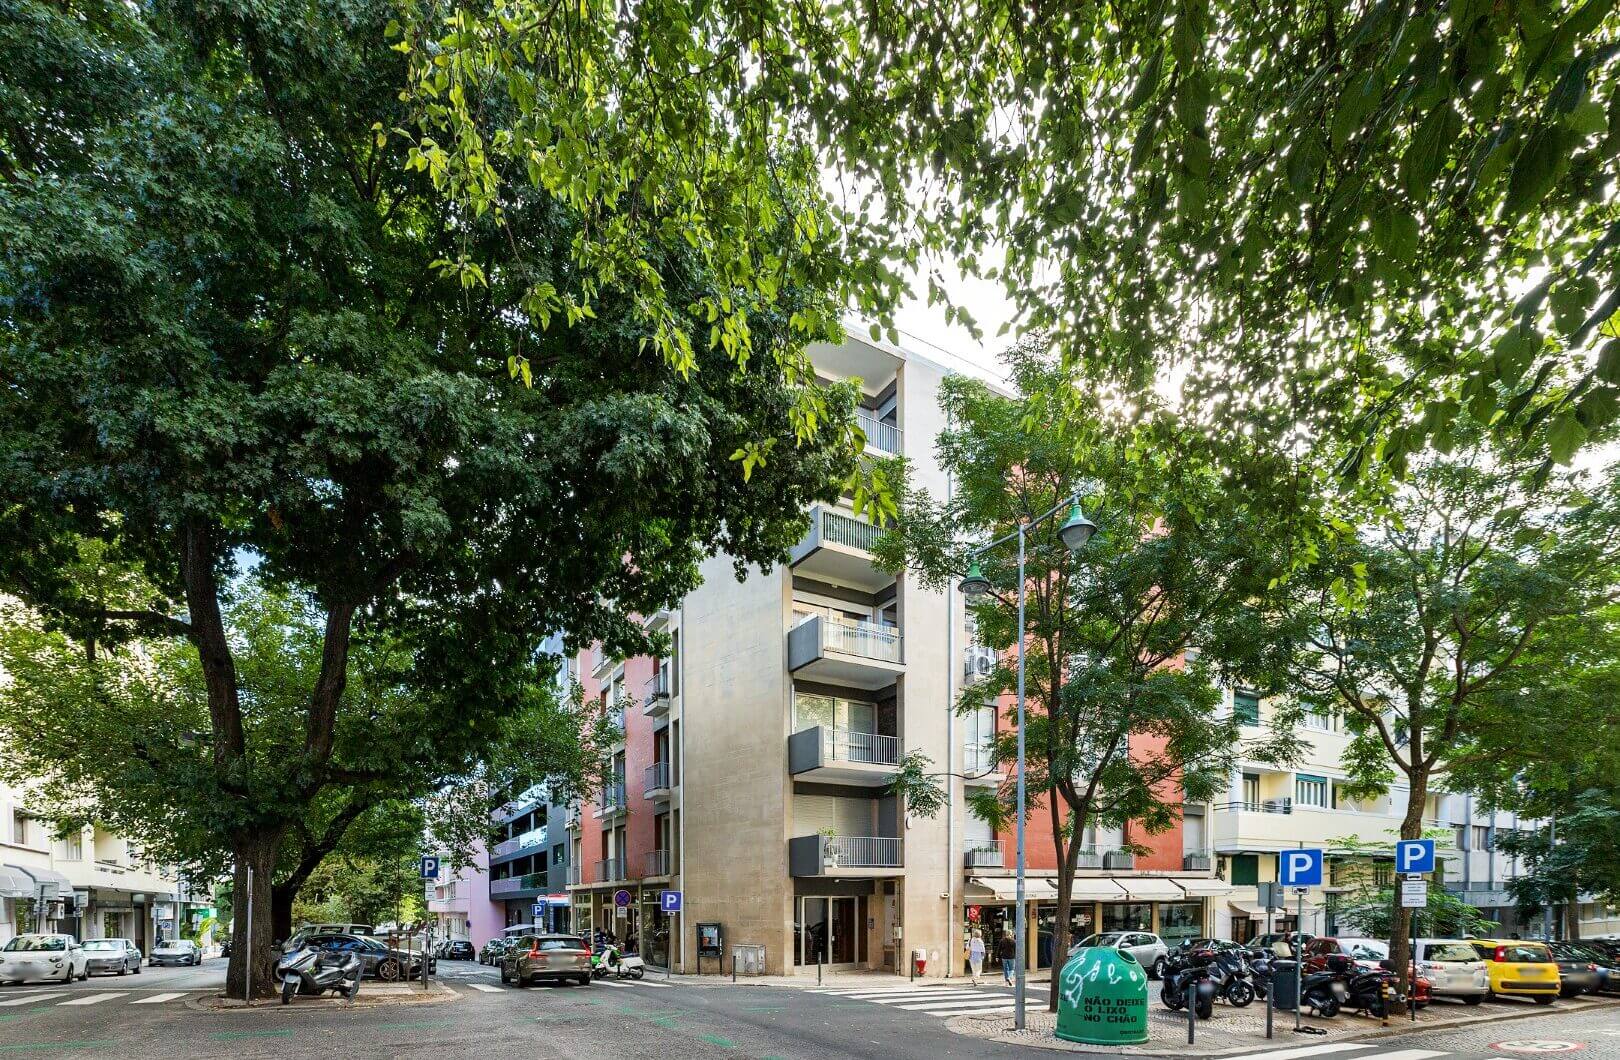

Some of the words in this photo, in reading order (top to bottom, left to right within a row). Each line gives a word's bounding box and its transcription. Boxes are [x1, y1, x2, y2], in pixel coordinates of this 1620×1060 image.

[1404, 843, 1426, 870] P
[424, 859, 436, 876] P
[1289, 853, 1313, 882] P
[666, 894, 677, 908] P
[534, 905, 542, 915] P
[1084, 996, 1111, 1006] NÃO
[1117, 998, 1145, 1006] DEIXE
[1084, 1005, 1093, 1013] O
[1098, 1006, 1127, 1014] LIXO
[1084, 1014, 1101, 1022] NO
